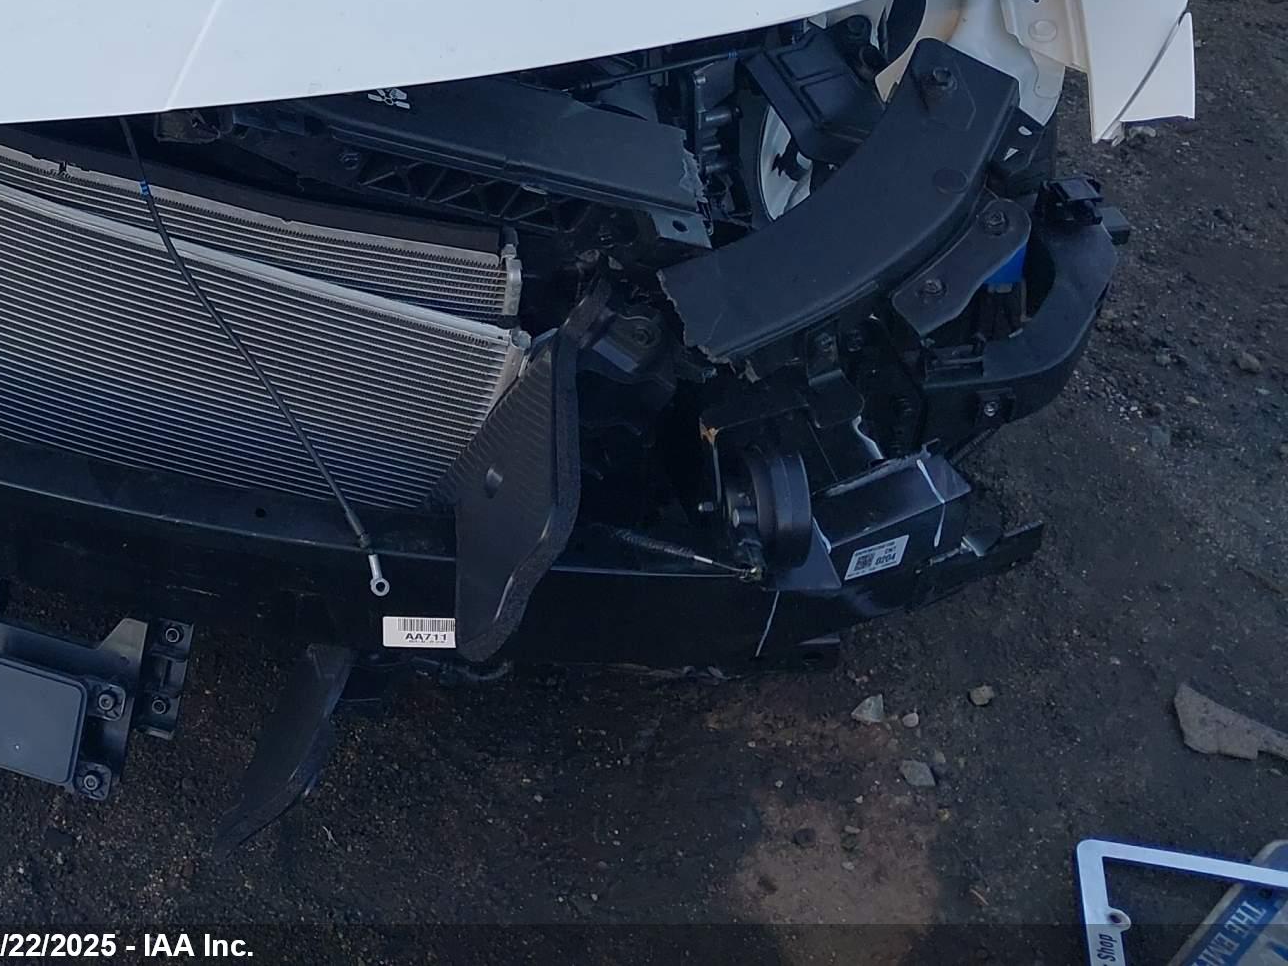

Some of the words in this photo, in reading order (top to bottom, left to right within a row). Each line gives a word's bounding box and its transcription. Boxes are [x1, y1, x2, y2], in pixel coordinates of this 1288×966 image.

[405, 632, 447, 641] AA711
[1223, 900, 1267, 938] THE
[1096, 933, 1117, 962] Shop
